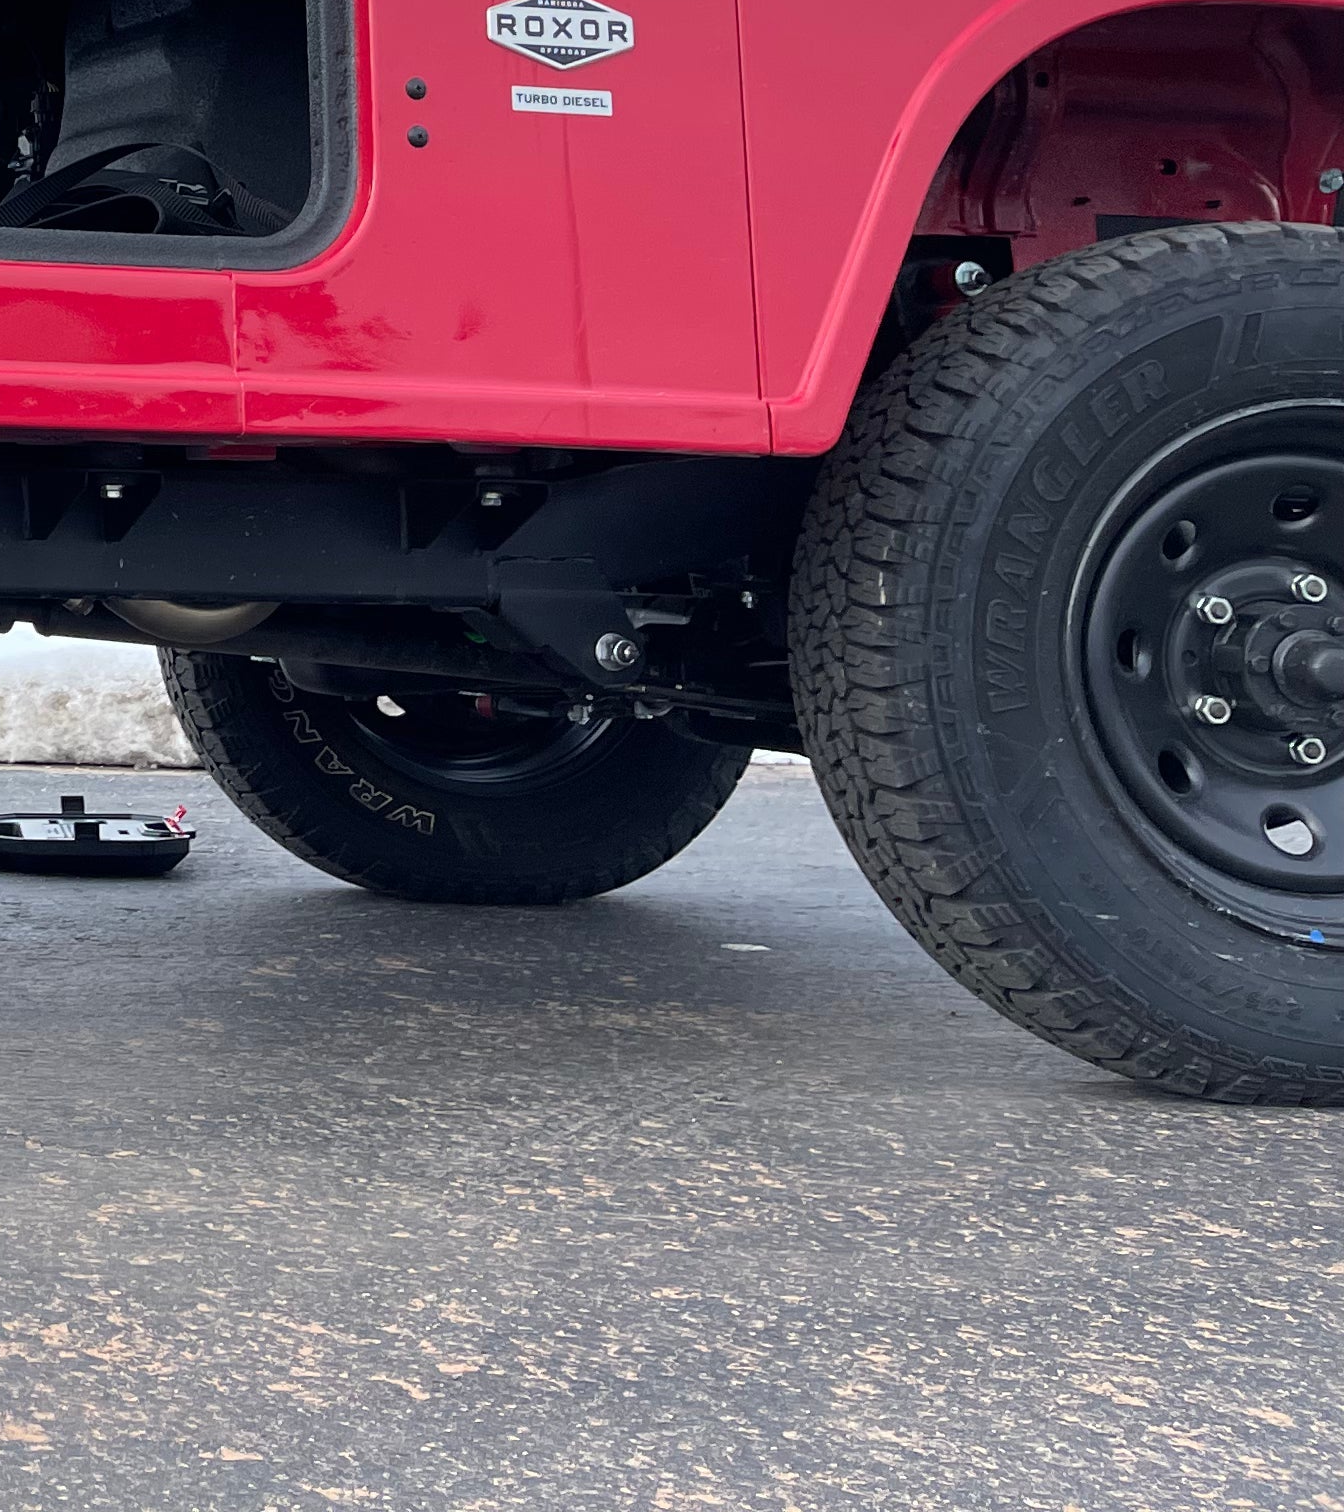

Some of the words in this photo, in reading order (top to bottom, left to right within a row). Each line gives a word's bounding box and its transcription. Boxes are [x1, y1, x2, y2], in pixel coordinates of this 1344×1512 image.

[496, 13, 629, 43] ROXOR
[539, 47, 587, 56] OFFROAD
[515, 92, 558, 105] TURBO
[563, 95, 608, 109] DIESEL
[983, 356, 1170, 716] WRANGLER
[267, 667, 437, 837] WRANG
